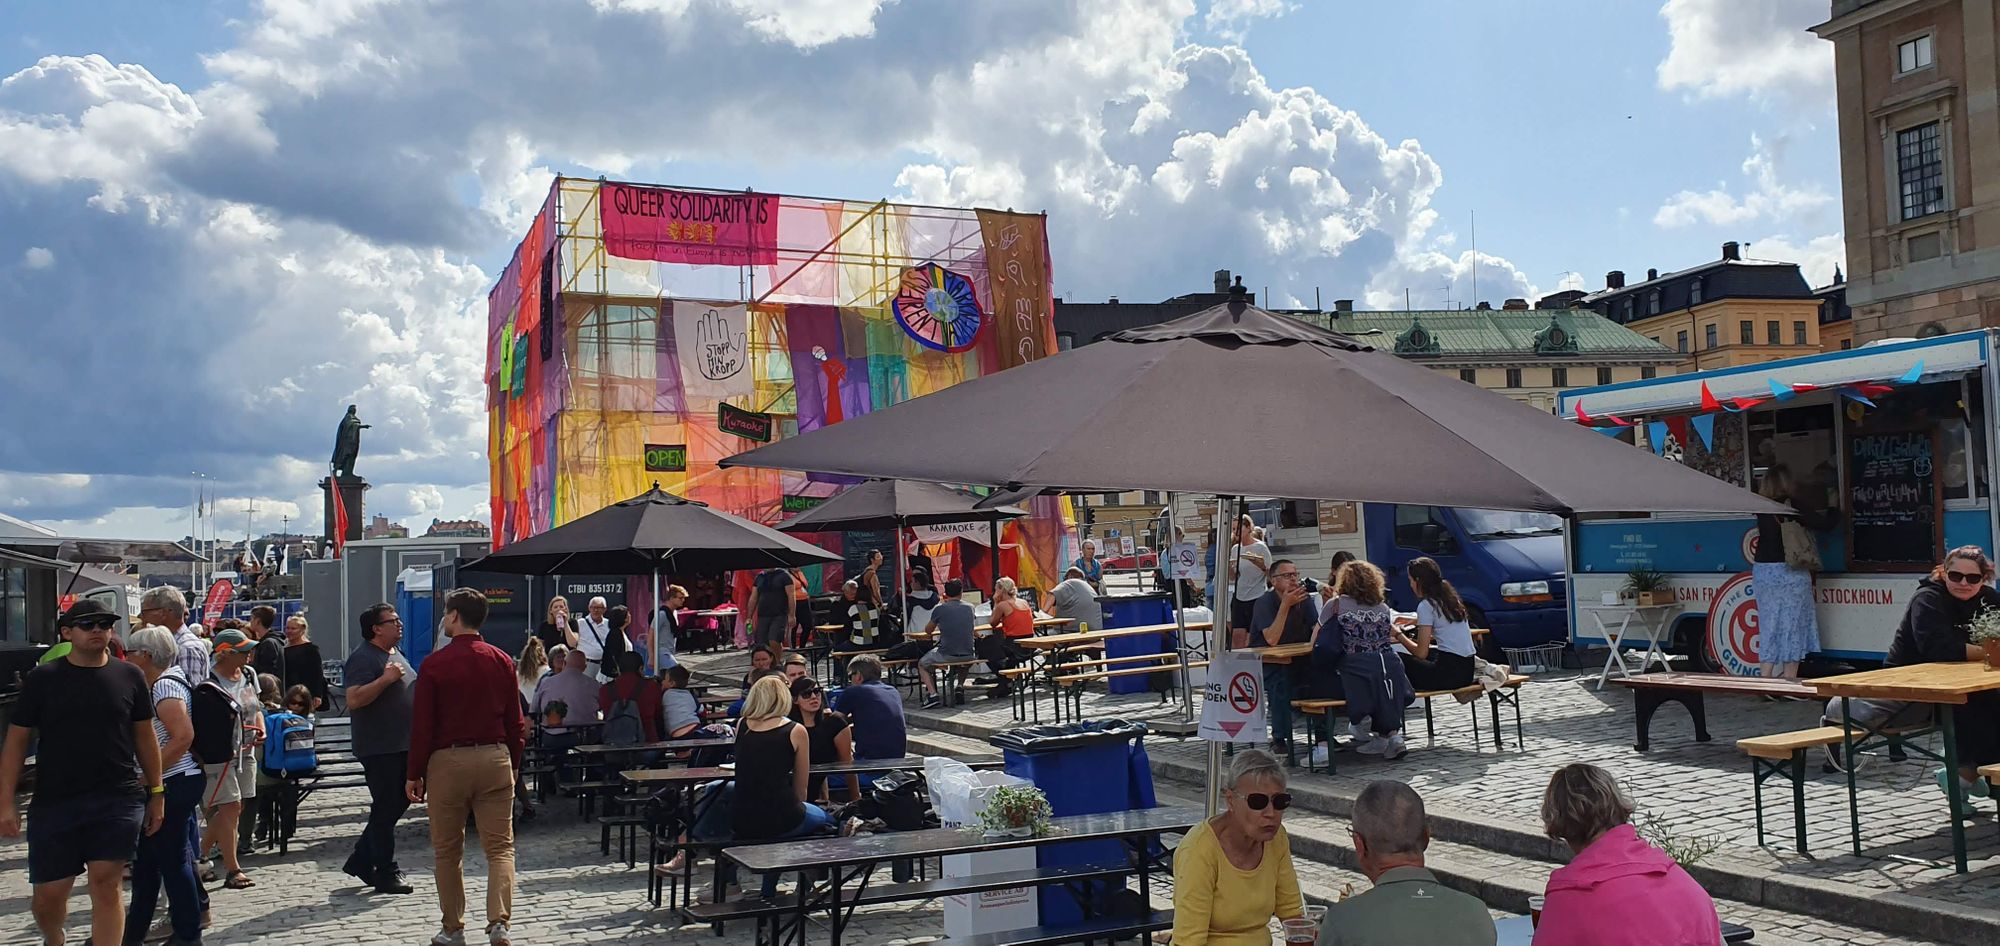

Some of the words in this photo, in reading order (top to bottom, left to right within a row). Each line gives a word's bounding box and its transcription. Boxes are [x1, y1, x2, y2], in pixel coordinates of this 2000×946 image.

[614, 187, 664, 218] QUEER
[671, 194, 753, 224] SOLIDARITY
[757, 198, 769, 225] IS
[706, 342, 730, 358] STOPP
[708, 356, 724, 371] MIN
[710, 359, 736, 378] KROPP
[646, 450, 685, 467] OPEN
[568, 584, 586, 594] CTBU
[589, 584, 615, 593] 835137
[1680, 587, 1699, 601] SAN
[1822, 588, 1893, 605] STOCKHOLM
[1726, 591, 1742, 607] THE
